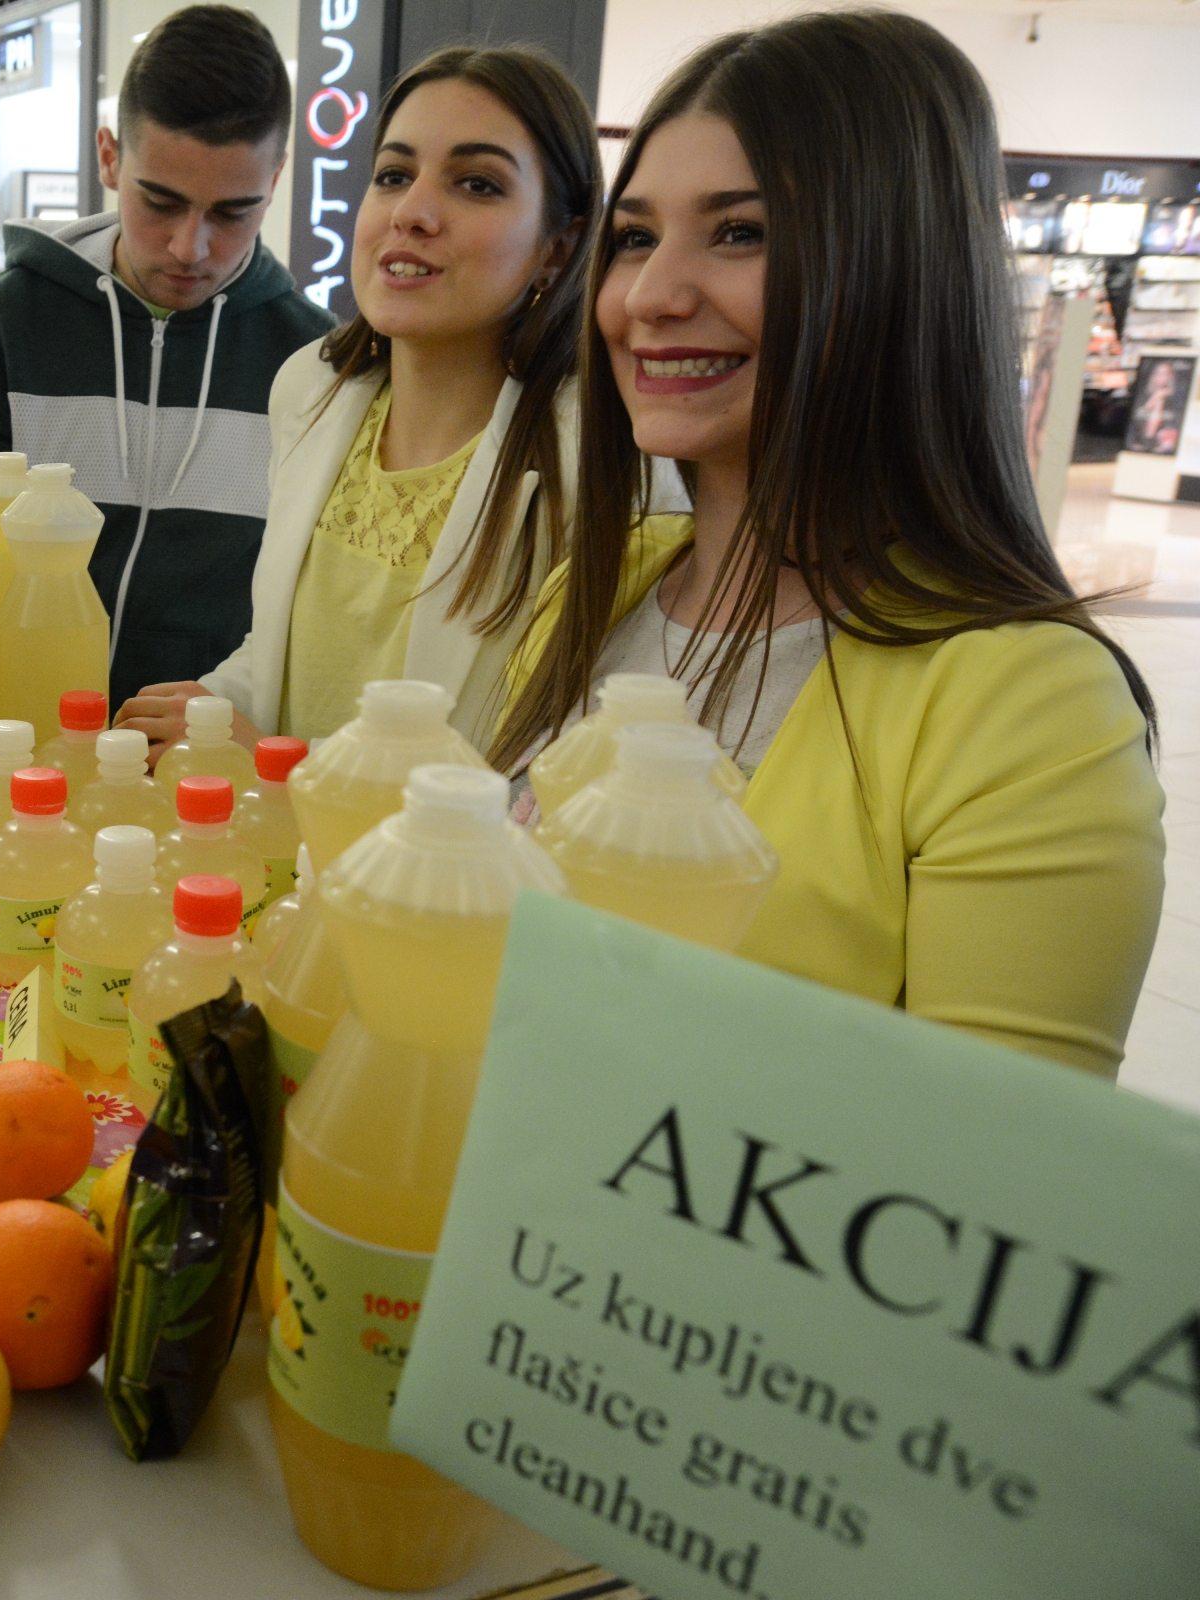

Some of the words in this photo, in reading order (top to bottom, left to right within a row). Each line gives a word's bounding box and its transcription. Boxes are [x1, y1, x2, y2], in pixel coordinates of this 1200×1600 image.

[1100, 169, 1146, 195] Dior
[8, 986, 29, 1049] CENA
[149, 1037, 167, 1052] 100
[602, 1103, 1200, 1450] AKCIJA
[487, 1320, 669, 1447] flašice
[681, 1431, 871, 1548] gratis
[511, 1226, 586, 1309] Uz
[601, 1271, 880, 1443] kupljene
[898, 1416, 1039, 1520] dve
